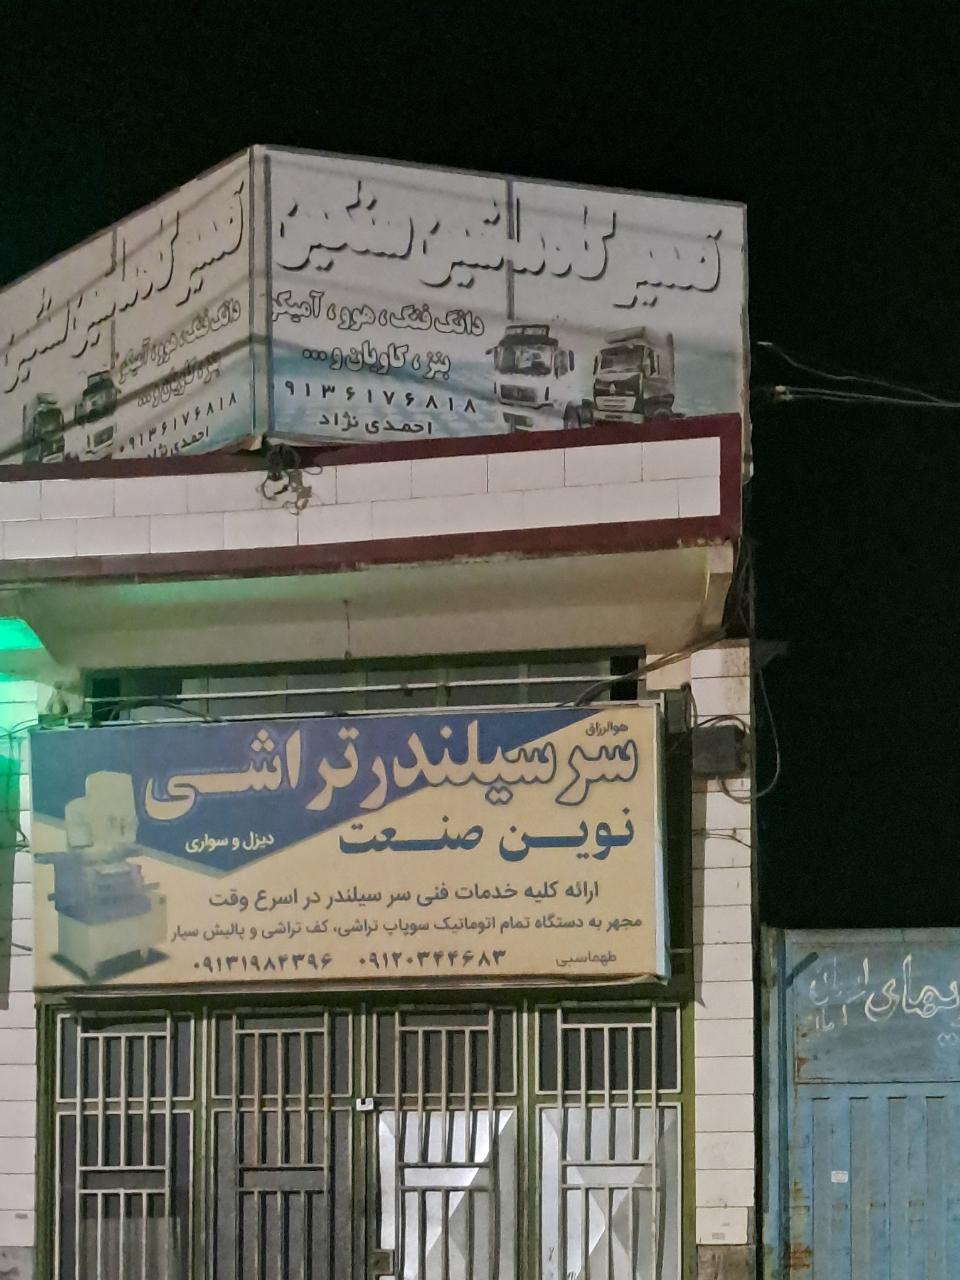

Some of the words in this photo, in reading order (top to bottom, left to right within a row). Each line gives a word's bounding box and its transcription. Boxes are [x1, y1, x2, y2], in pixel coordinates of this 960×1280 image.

[319, 410, 360, 433] نژاد
[364, 419, 433, 436] احمدی
[184, 832, 229, 854] سواری
[232, 837, 241, 851] و
[242, 831, 276, 851] دیزل
[338, 815, 484, 855] صنعت
[499, 806, 635, 863] نوین
[208, 889, 249, 912] وقت
[254, 887, 299, 912] اسرع
[302, 890, 322, 910] در
[326, 886, 382, 910] سیلندر
[386, 890, 412, 909] سر
[416, 882, 450, 907] فنی
[454, 882, 519, 901] خدمات
[523, 880, 559, 904] کلیه
[564, 880, 600, 904] ارائه
[261, 921, 302, 940] تراشی
[305, 919, 330, 934] کف
[382, 917, 430, 937] سوپاپ
[433, 916, 496, 936] اتوماتیک
[499, 917, 530, 935] تمام
[534, 912, 584, 931] دستگاه
[588, 917, 602, 932] به
[170, 924, 200, 944] سیار
[249, 926, 258, 941] و
[555, 949, 618, 968] طهماسبی
